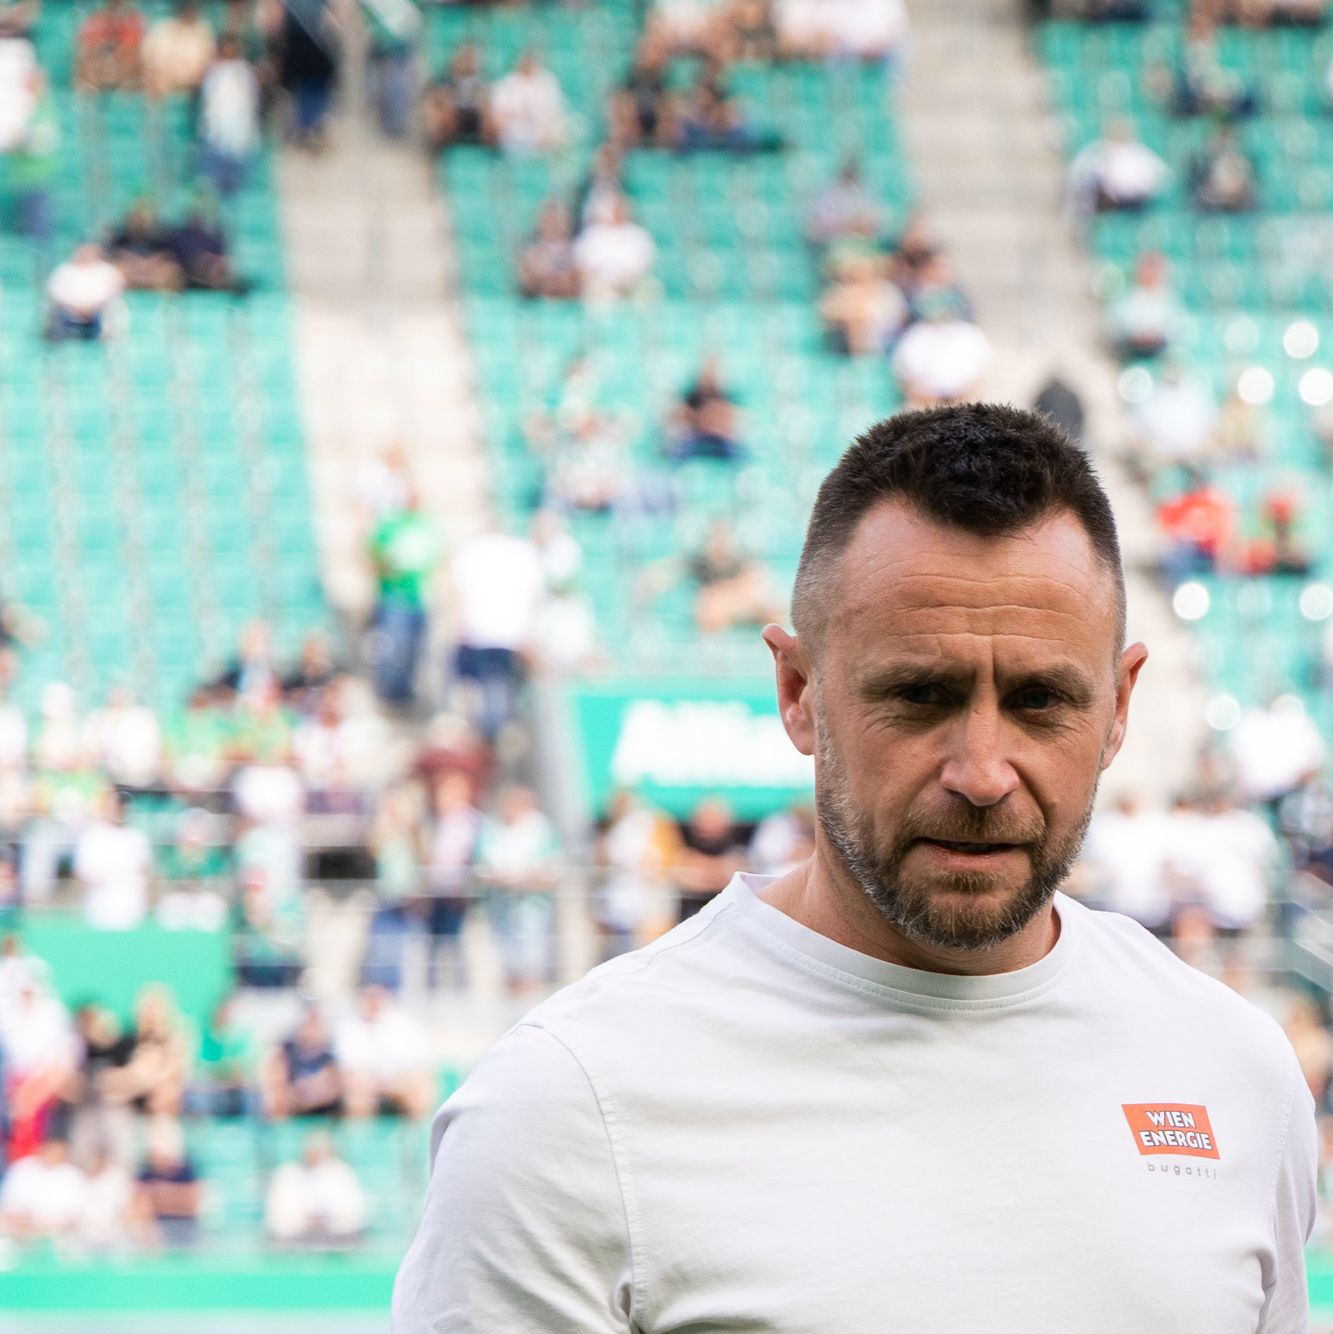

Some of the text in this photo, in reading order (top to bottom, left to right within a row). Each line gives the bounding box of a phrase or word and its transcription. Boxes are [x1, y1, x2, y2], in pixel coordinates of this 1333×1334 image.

[1145, 1111, 1196, 1128] WIEN
[1139, 1130, 1212, 1150] ENERGIE
[1147, 1162, 1216, 1180] bugatti
